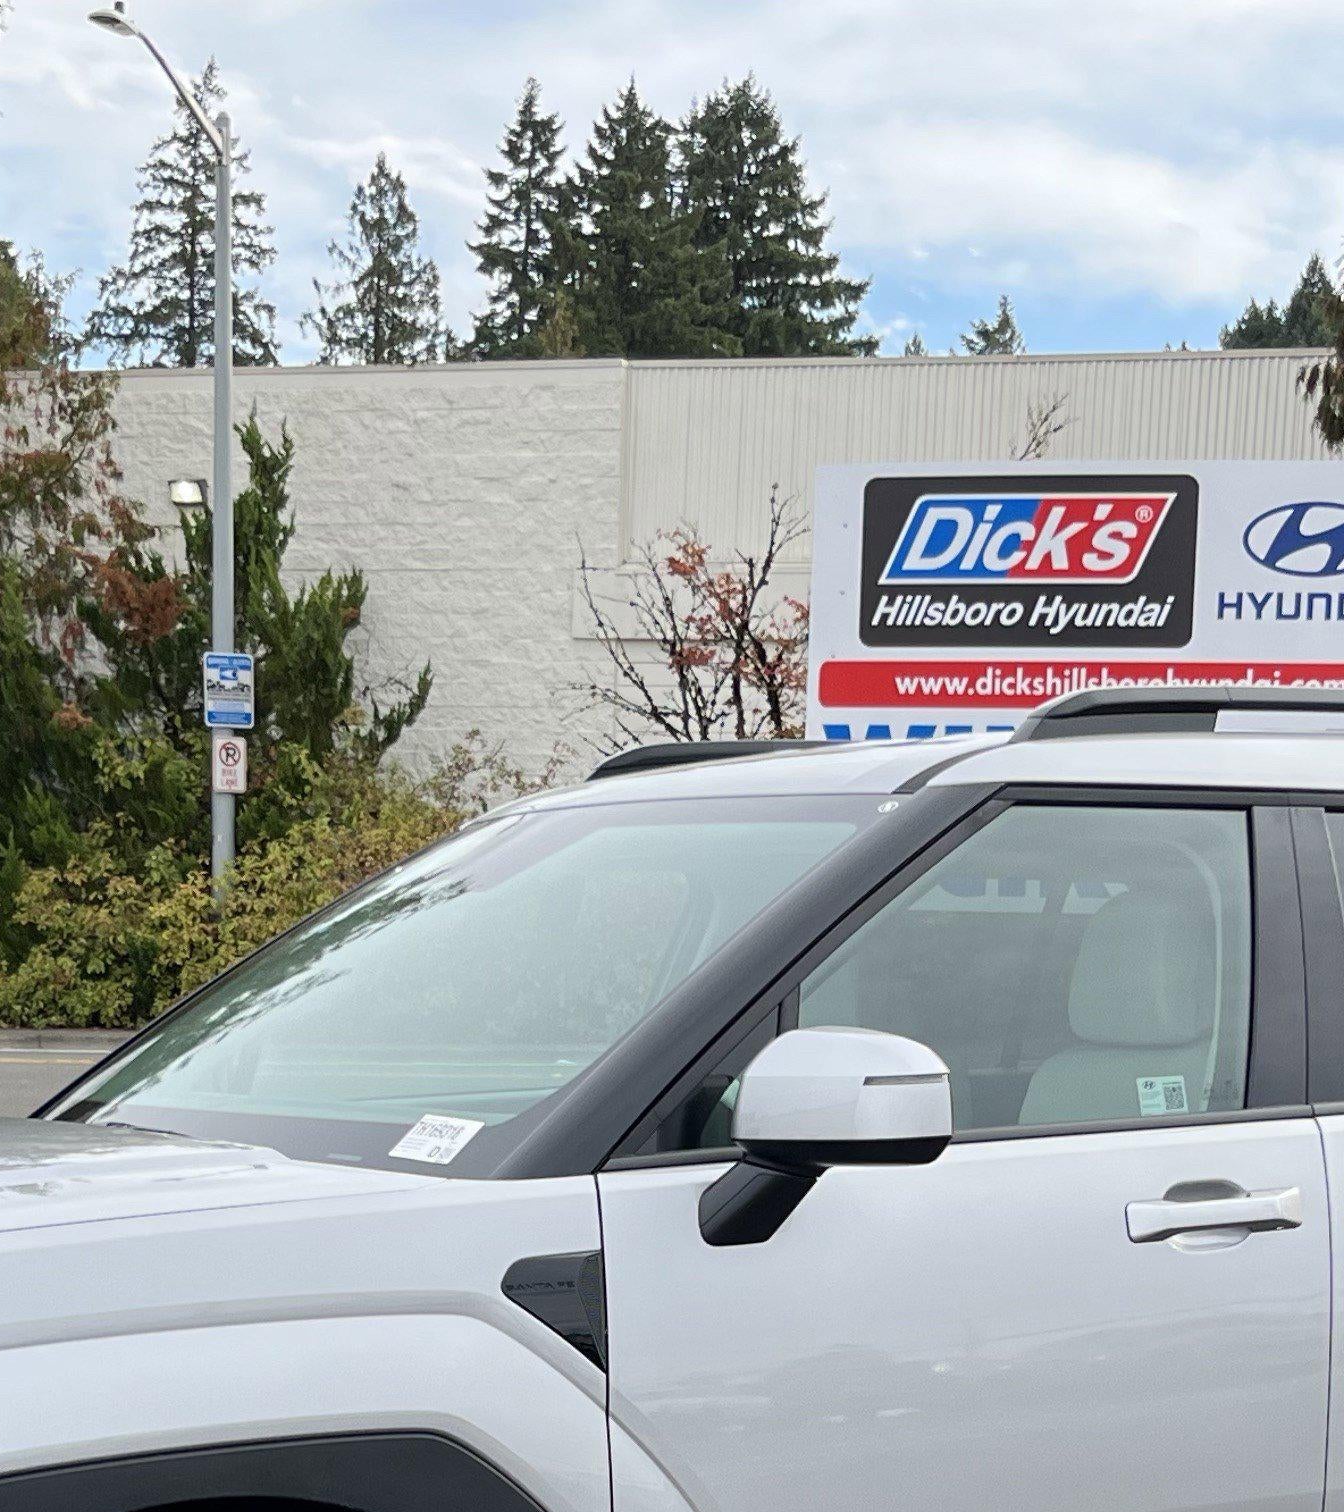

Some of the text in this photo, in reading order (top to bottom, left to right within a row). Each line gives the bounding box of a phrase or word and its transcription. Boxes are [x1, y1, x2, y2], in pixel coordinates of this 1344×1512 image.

[901, 502, 1138, 572] Dick's
[871, 594, 1175, 635] Hillsboro Hyundai
